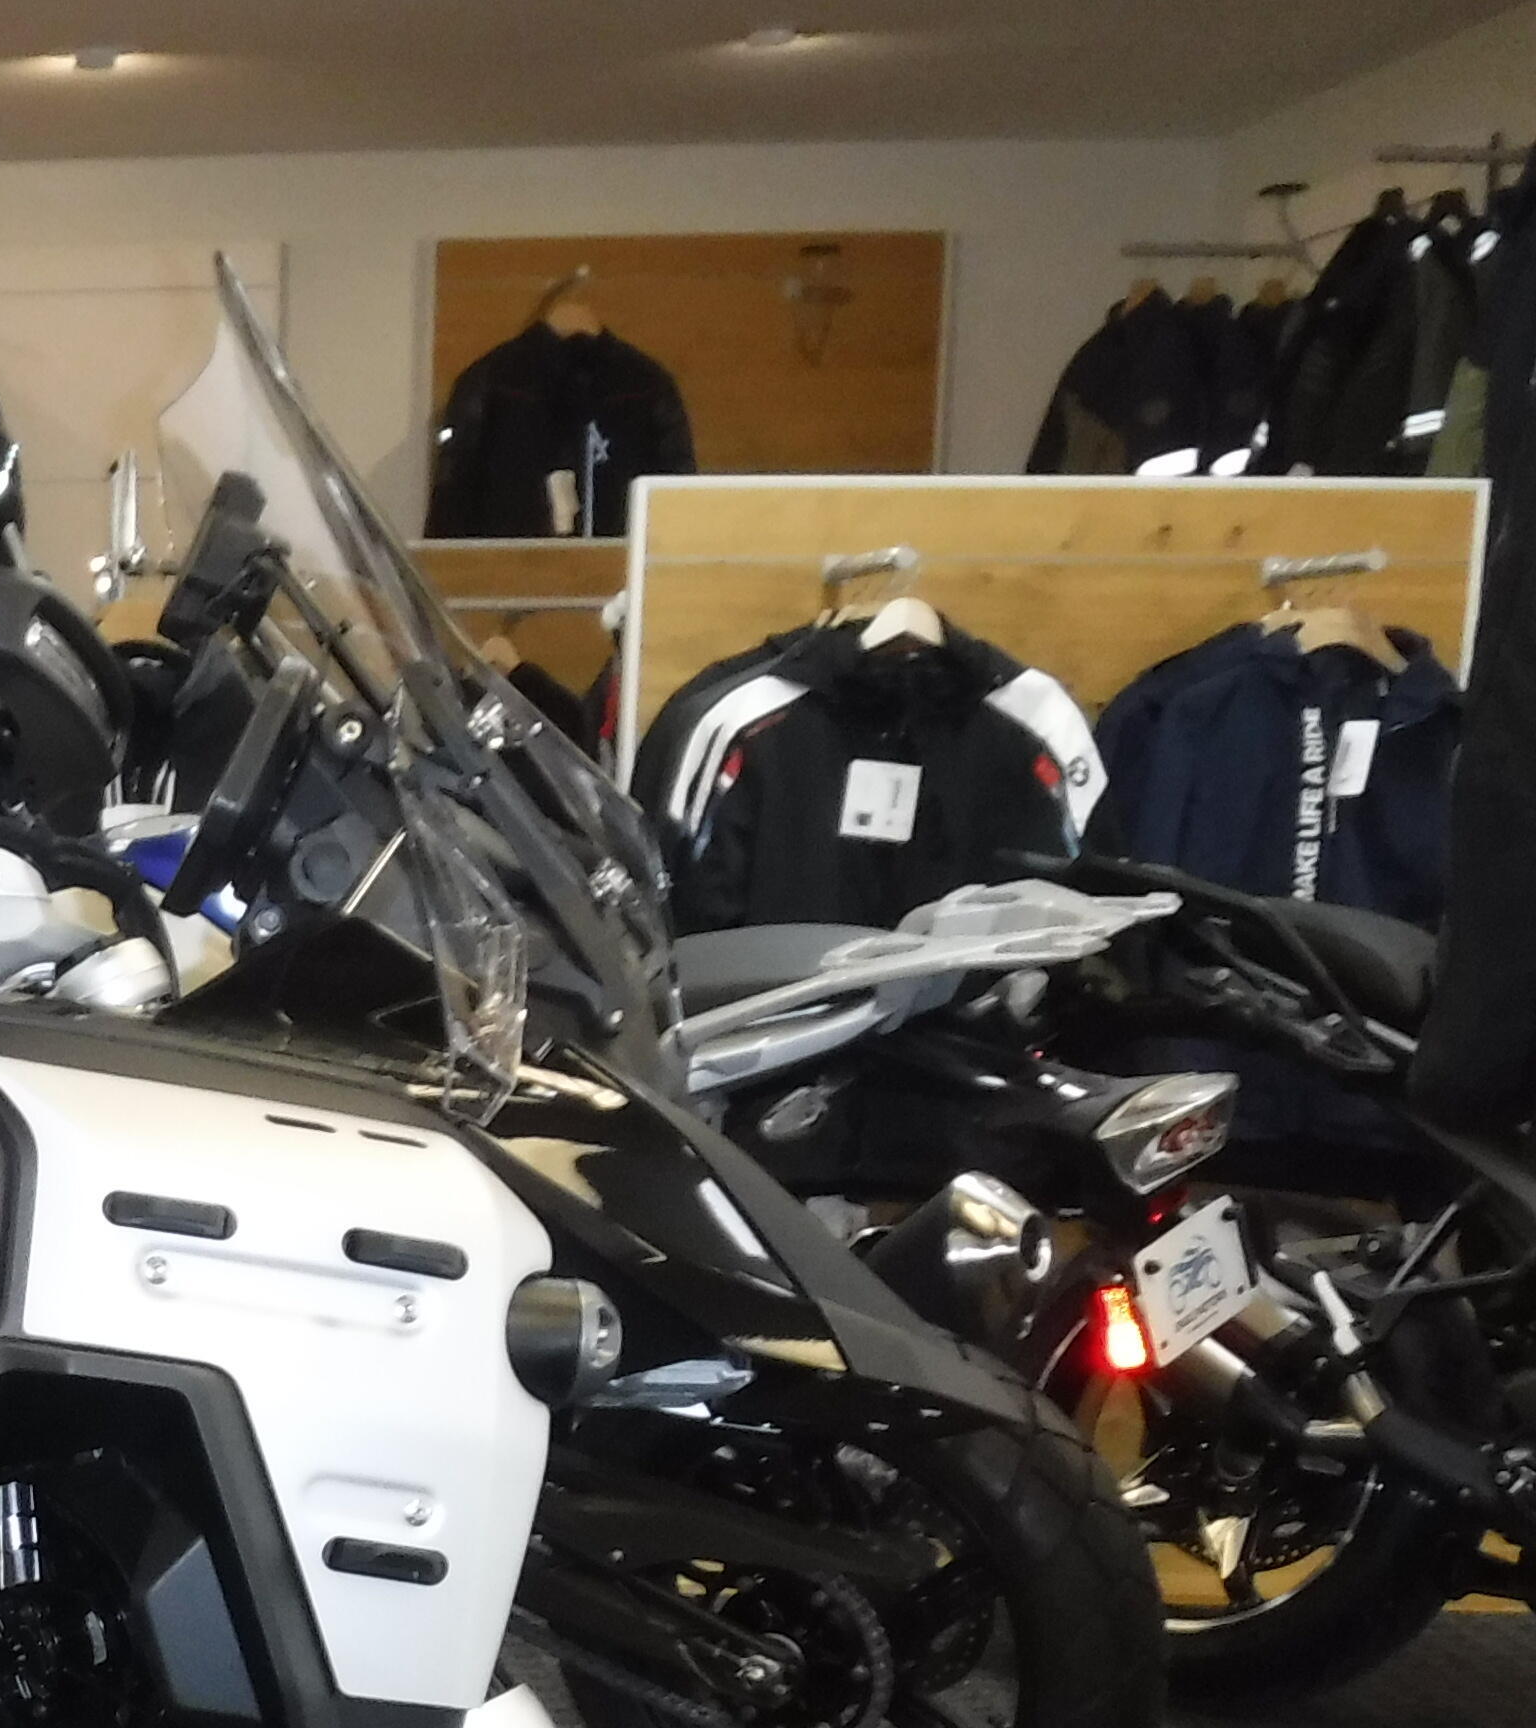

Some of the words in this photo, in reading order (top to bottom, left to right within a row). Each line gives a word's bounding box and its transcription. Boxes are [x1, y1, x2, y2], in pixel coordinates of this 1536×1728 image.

[1301, 706, 1327, 764] RIDE
[1301, 765, 1327, 785] A
[1296, 787, 1325, 838] LIFE
